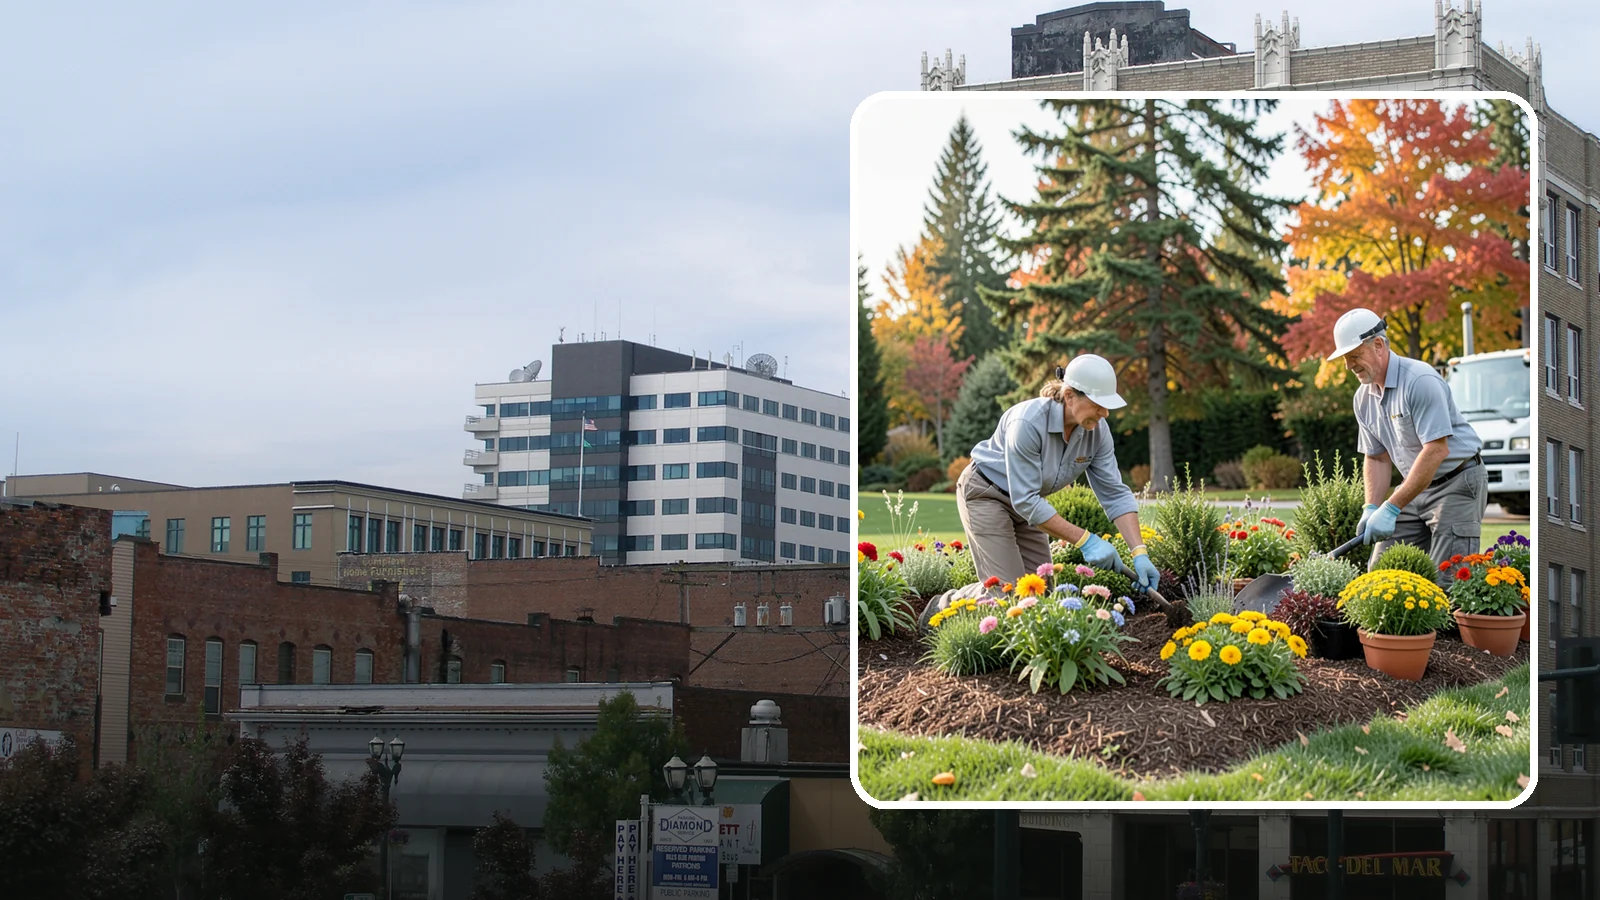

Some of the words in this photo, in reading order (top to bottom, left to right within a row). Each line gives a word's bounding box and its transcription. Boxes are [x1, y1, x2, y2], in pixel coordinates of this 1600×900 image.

[660, 818, 713, 832] DIAMOND
[1022, 815, 1070, 828] BUILDING
[617, 824, 625, 852] PAY
[628, 824, 637, 852] PAY
[690, 846, 716, 854] PARKING
[616, 855, 625, 893] HERE
[627, 855, 637, 893] HERE
[1345, 856, 1385, 875] DEL
[1392, 857, 1442, 877] MAR
[684, 889, 709, 897] PARKING
